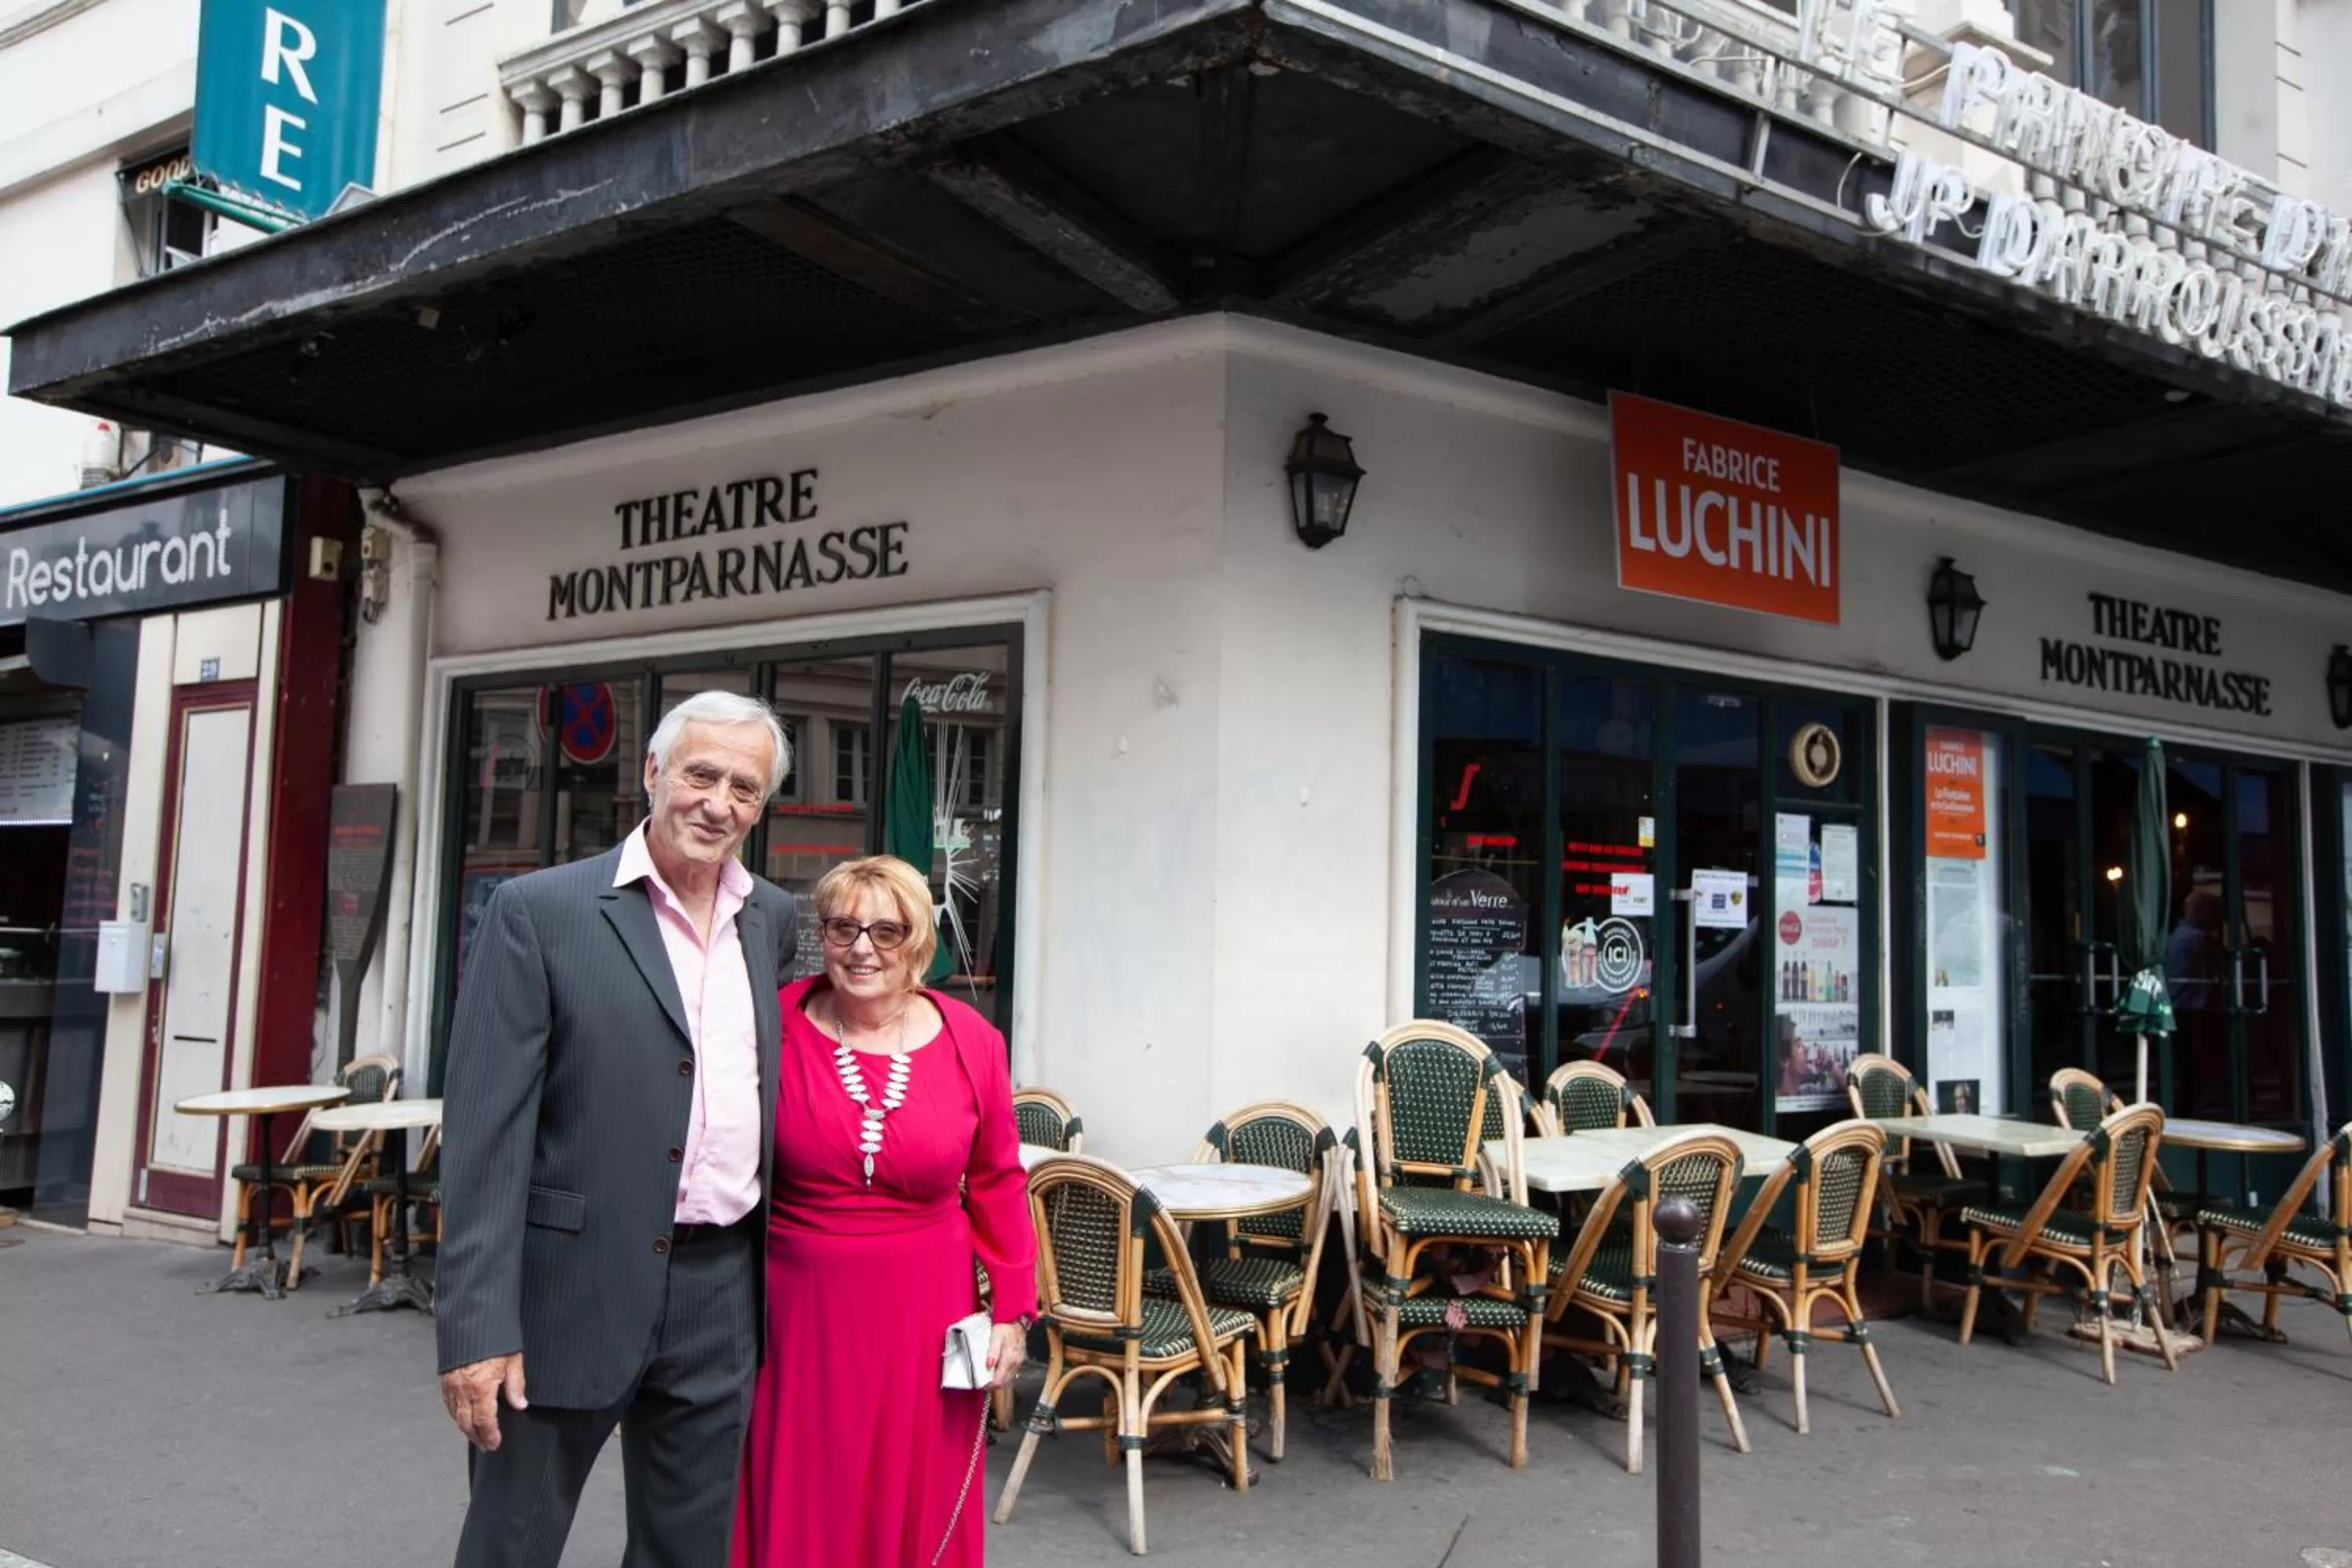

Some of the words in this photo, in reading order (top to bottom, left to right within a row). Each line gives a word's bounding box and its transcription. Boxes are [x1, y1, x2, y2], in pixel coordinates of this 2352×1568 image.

[1682, 436, 1781, 493] FABRICE
[615, 469, 818, 550] THEATRE
[1627, 472, 1831, 588] LUCHINI
[6, 507, 232, 609] Restaurant
[546, 521, 909, 622] MONTPARNASSE
[2087, 591, 2223, 657] THEATRE
[2039, 637, 2272, 717] MONTPARNASSE
[1927, 752, 1976, 777] LUCHINI
[1607, 946, 1628, 964] ICI
